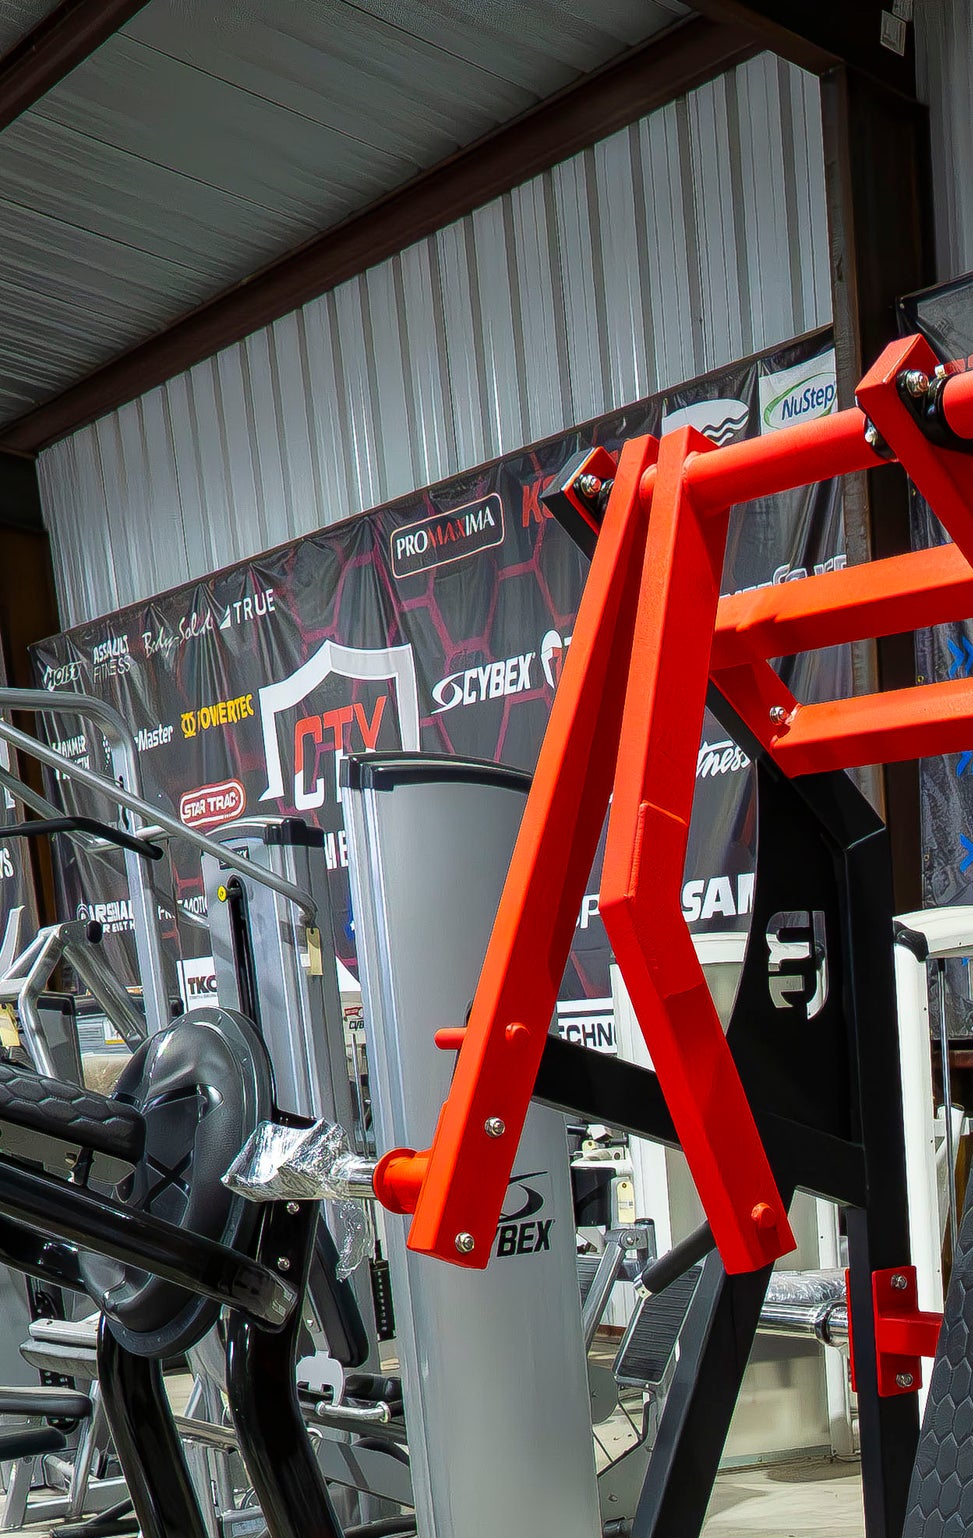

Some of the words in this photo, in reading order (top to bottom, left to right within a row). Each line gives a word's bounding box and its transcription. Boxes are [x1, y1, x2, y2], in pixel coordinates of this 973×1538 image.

[781, 383, 835, 421] NuStep
[396, 506, 496, 560] PROMAXIMA
[233, 588, 276, 624] TRUE
[462, 652, 533, 706] CYBEX
[134, 724, 174, 753] Master
[183, 800, 206, 820] STAR
[497, 1219, 554, 1258] BEX
